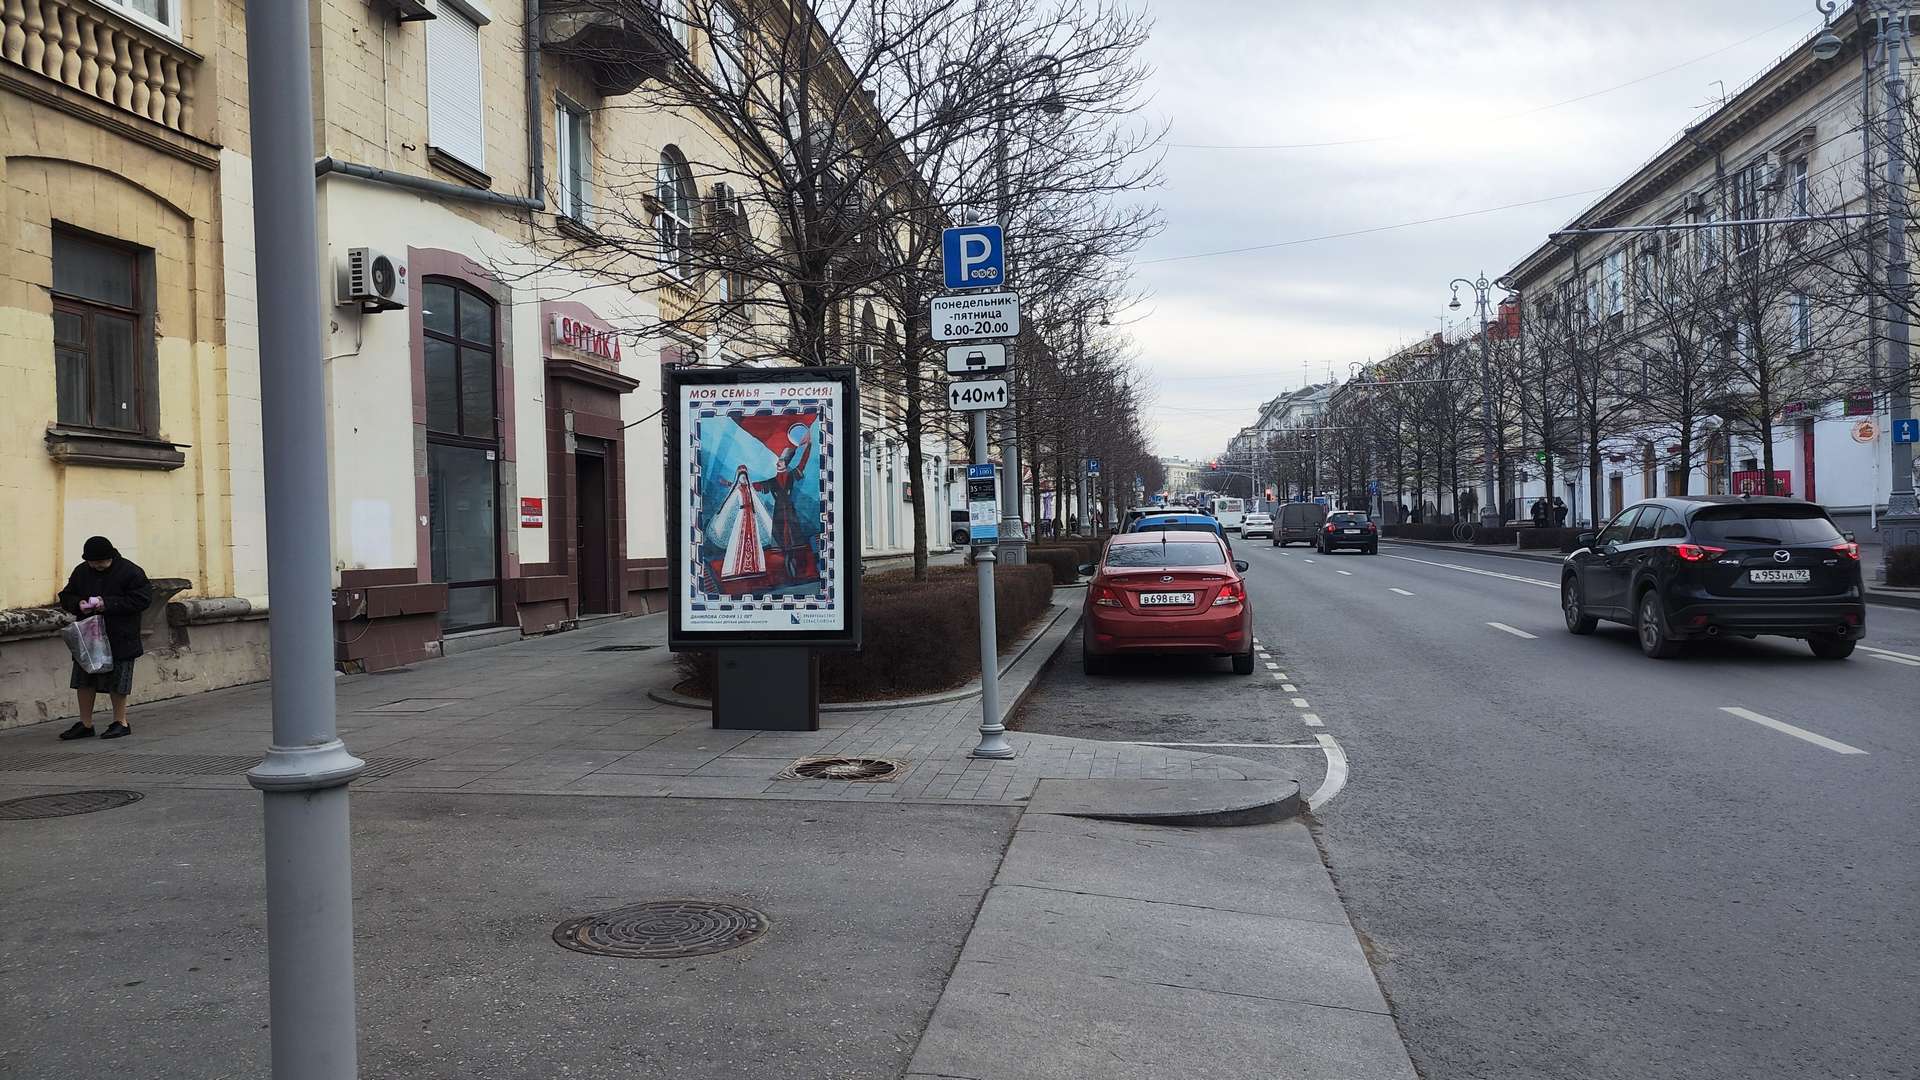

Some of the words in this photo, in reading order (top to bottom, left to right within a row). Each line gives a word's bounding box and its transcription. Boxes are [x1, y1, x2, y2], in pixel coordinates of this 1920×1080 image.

[960, 233, 992, 281] P
[934, 297, 1017, 310] понедельник-
[949, 310, 1002, 320] -пятница
[943, 321, 1009, 336] 8.00-20.00
[562, 317, 621, 362] ОПТИКА
[689, 389, 717, 399] МОЯ
[721, 388, 760, 398] СЕМЬЯ
[780, 386, 833, 397] РОССИЯ!
[961, 388, 995, 403] 40м
[970, 468, 976, 476] P
